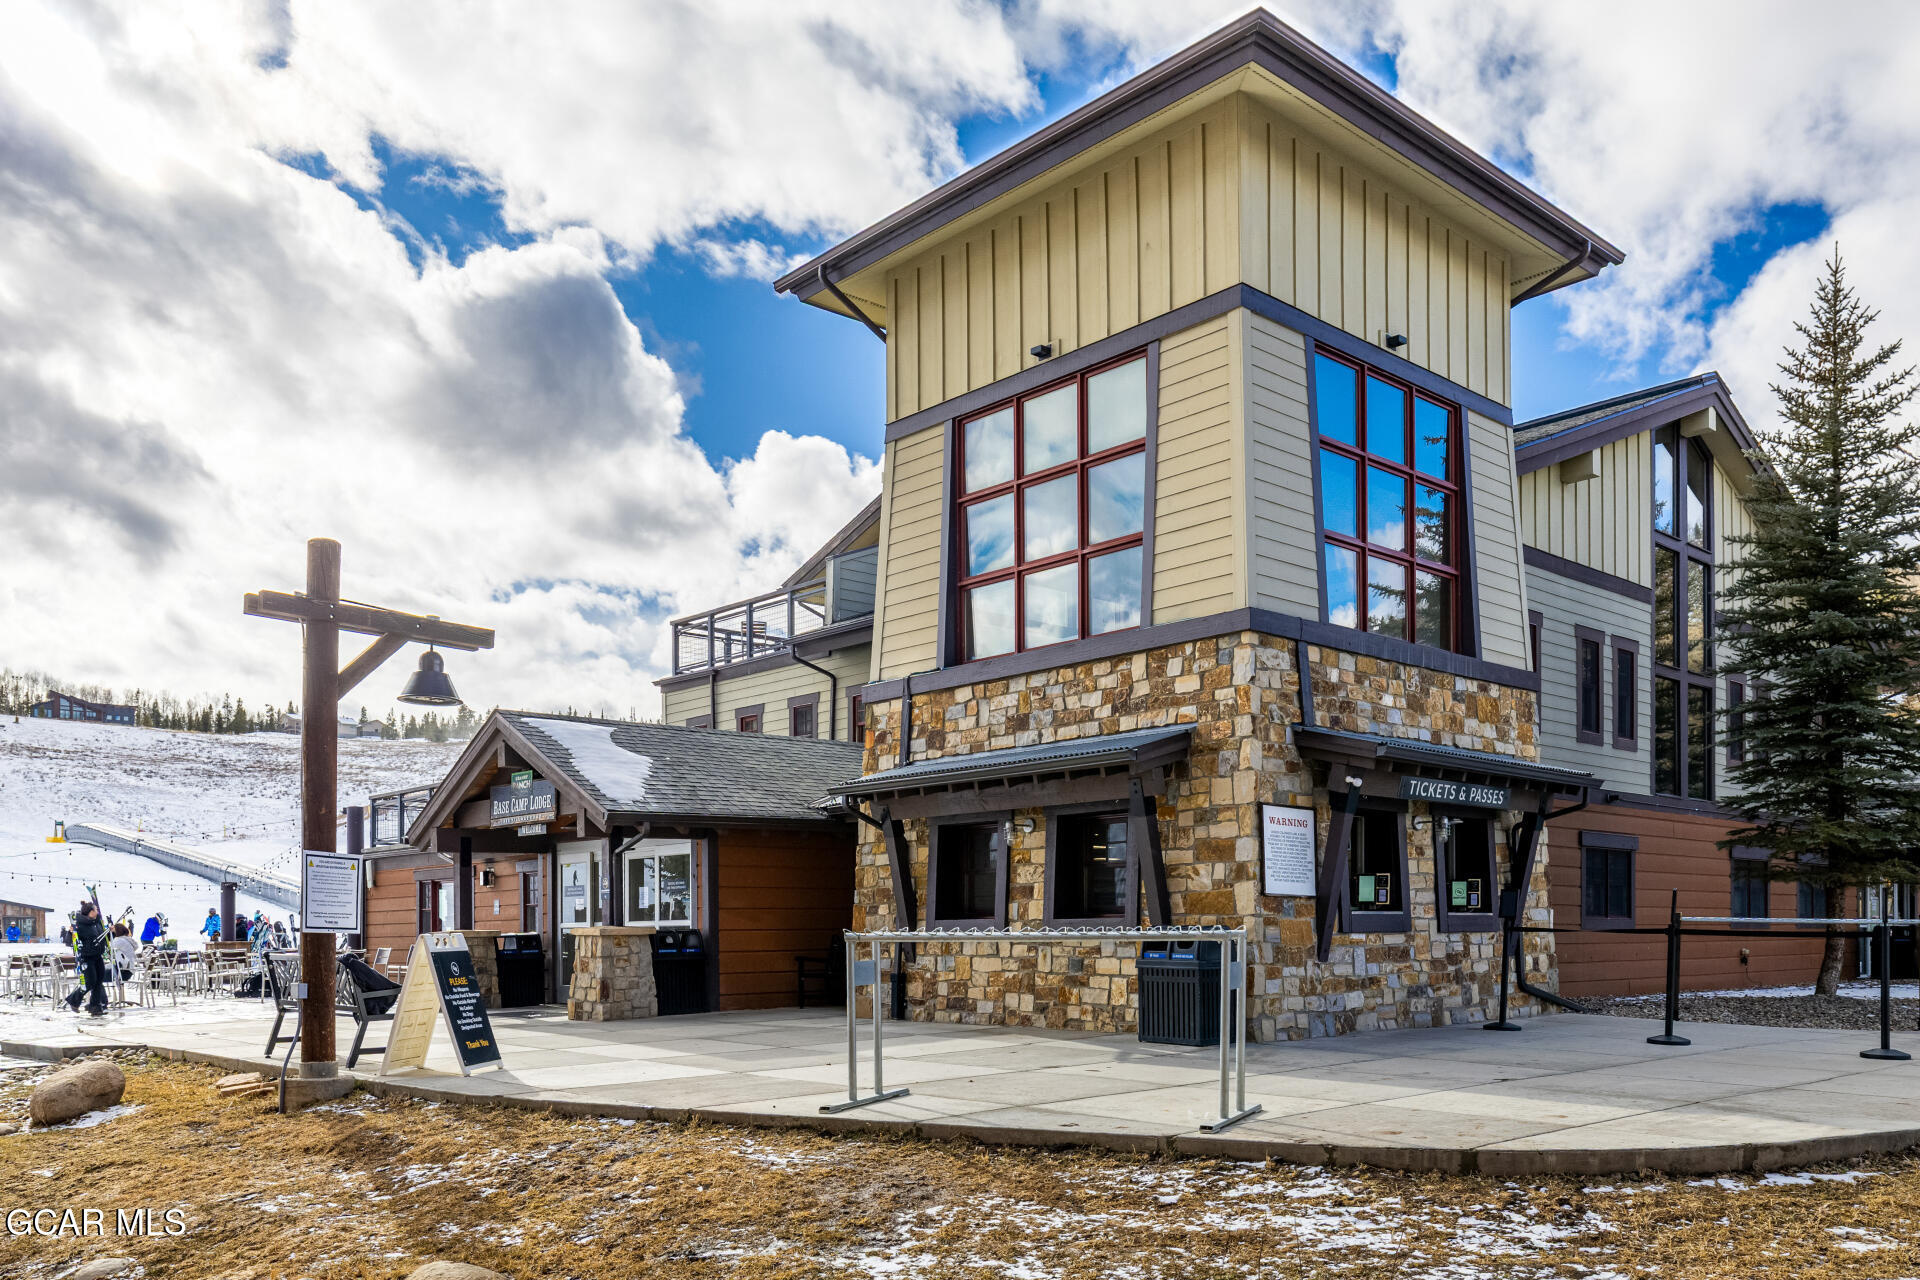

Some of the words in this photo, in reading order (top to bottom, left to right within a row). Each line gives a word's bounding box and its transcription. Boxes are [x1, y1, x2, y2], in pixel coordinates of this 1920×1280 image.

[1410, 780, 1457, 800] TICKETS
[1459, 786, 1466, 801] &
[1469, 787, 1504, 805] PASSES
[493, 800, 510, 815] BASE
[511, 797, 529, 813] CAMP
[530, 794, 552, 810] LODGE
[1268, 816, 1308, 828] WARNING
[466, 1040, 480, 1048] Thank
